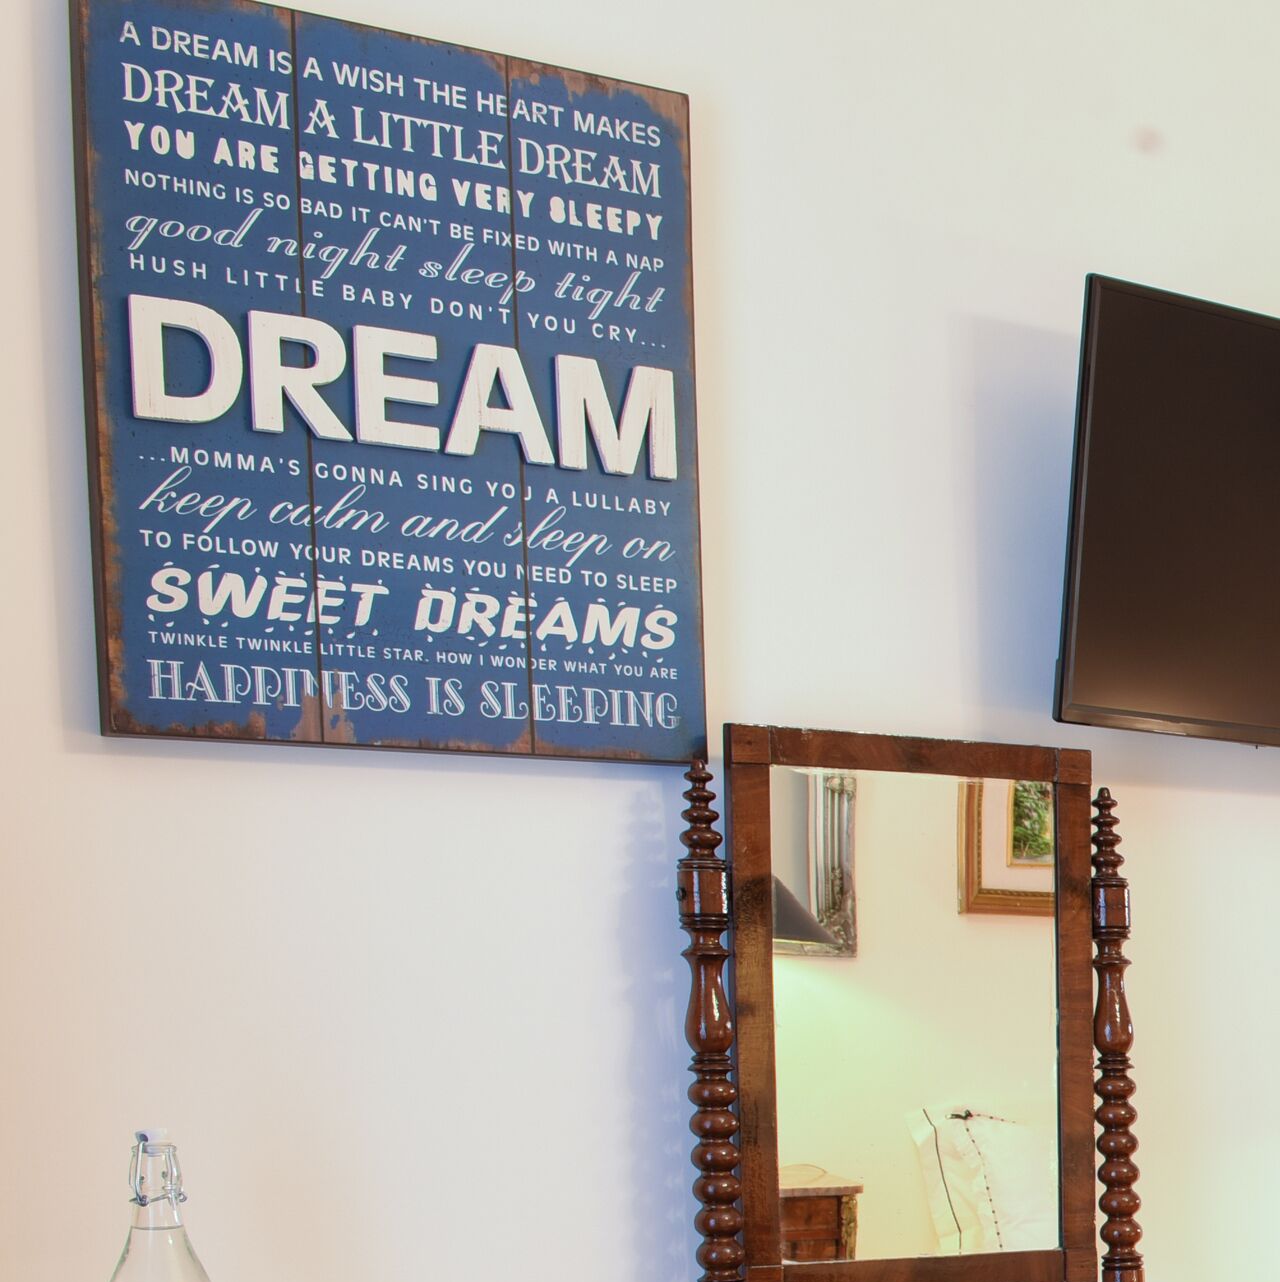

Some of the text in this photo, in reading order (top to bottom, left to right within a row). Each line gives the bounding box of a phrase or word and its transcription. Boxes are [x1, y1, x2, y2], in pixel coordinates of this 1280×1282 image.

[120, 21, 661, 147] A DREAM IS A WISH THE HEART MAKES
[120, 62, 662, 198] DREAM A LITTLE DREAM
[124, 120, 663, 241] YOU ARE GETTING VERY SLEEPY
[124, 168, 665, 273] NOTHING IS SO BAD IT CAN'T BE FIXED WITH A NAP
[125, 207, 666, 320] good night sleep tight
[129, 252, 207, 280] HUSH
[226, 267, 325, 298] LITTLE
[342, 284, 413, 310] BABY
[430, 297, 511, 325] DON'T
[527, 312, 576, 334] YOU
[129, 293, 678, 480] DREAM
[138, 465, 676, 568] keep calm and sleep on
[314, 463, 403, 488] GONNA
[417, 474, 473, 495] SING
[545, 488, 560, 505] A
[572, 491, 672, 517] LULLABY
[138, 529, 678, 594] TO FOLLOW YOUR DREAMS YOU NEED TO SLEEP
[146, 564, 679, 651] SWEET DREAMS
[146, 658, 682, 730] HAPPINESS IS SLEEPING
[148, 631, 228, 649] TWINKLE
[236, 637, 313, 654] TWINKLE
[320, 642, 376, 659] LITTLE
[436, 651, 473, 666] HOW
[479, 654, 484, 666] I
[564, 661, 607, 675] WHAT
[614, 664, 644, 678] YOU
[649, 666, 679, 680] ARE
